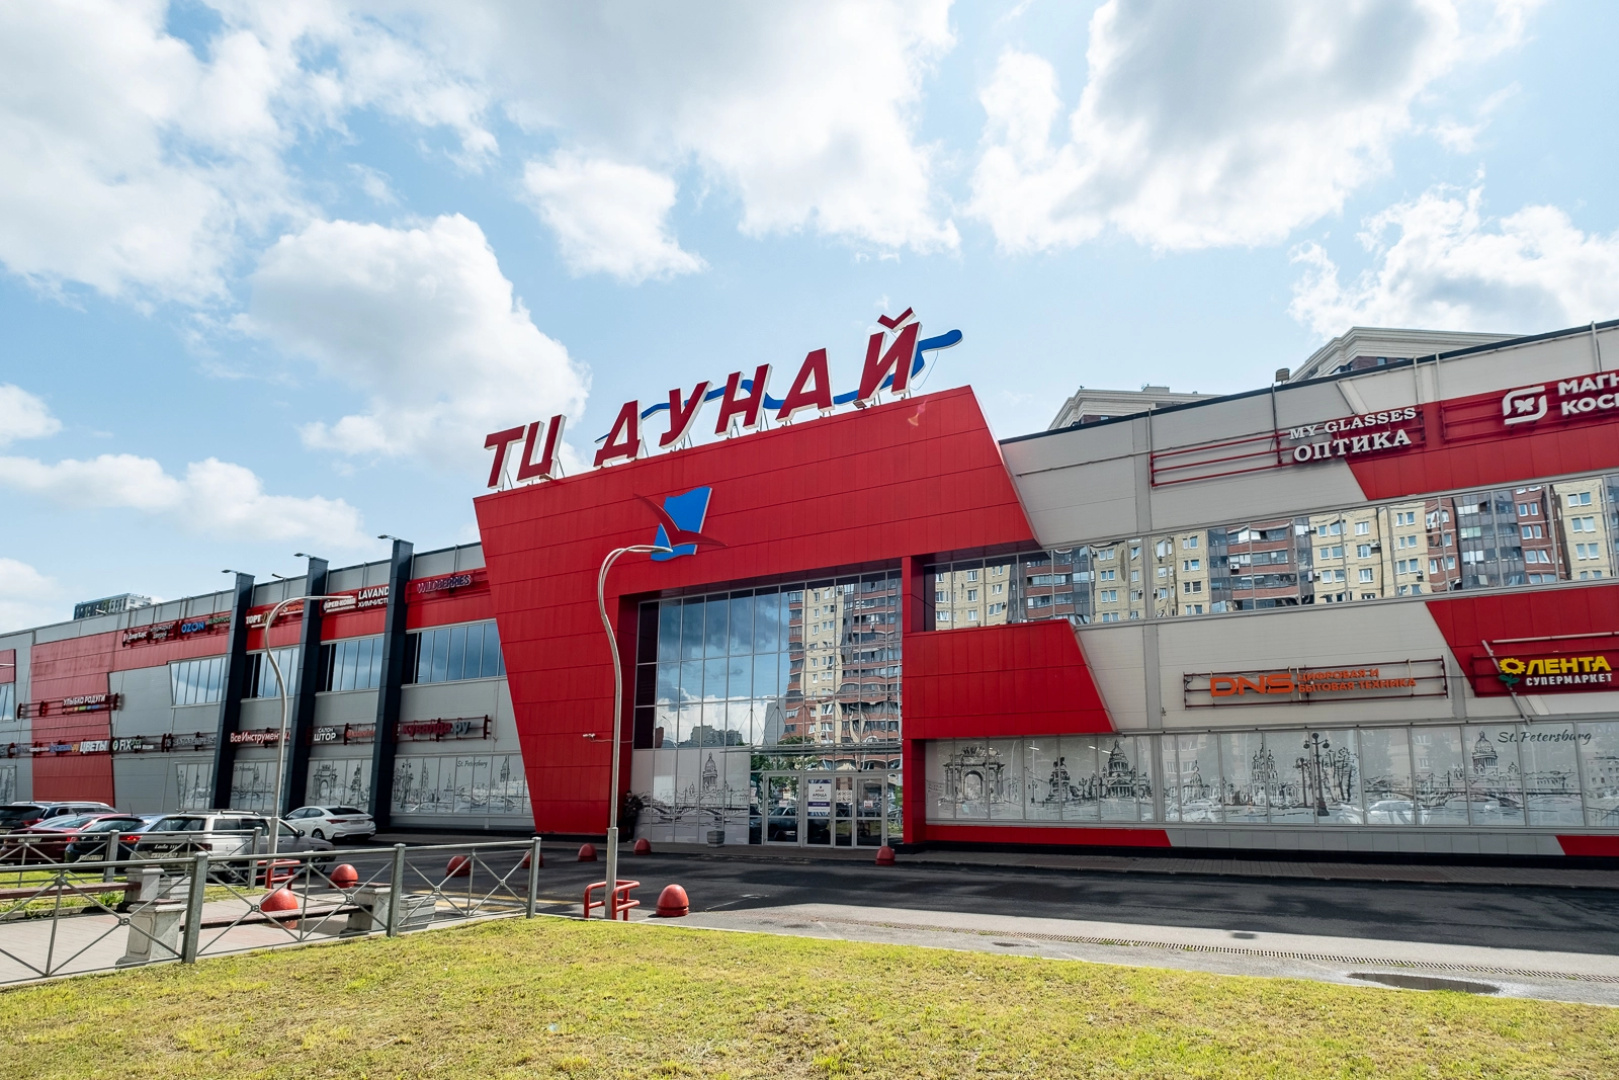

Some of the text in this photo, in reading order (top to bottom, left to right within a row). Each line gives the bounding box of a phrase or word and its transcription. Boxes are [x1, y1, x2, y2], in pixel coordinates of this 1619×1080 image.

[484, 306, 922, 489] ТЦ ДУНАЙ
[1289, 407, 1417, 440] MY GLASSES
[1294, 429, 1412, 462] ОПТИКА
[417, 575, 471, 593] WILDBERRIES
[181, 622, 206, 633] OZON
[1526, 656, 1612, 675] ЛЕНТА
[1297, 668, 1379, 682] ЦИФРОВАЯ И
[1526, 673, 1613, 687] СУПЕРМАРКЕТ
[1210, 673, 1295, 697] DNS
[1298, 678, 1417, 693] БЫТОВАЯ ТЕХНИКА
[314, 732, 337, 741] ШТОР
[1498, 732, 1517, 743] St.
[80, 741, 108, 753] ЦВЕТЫ
